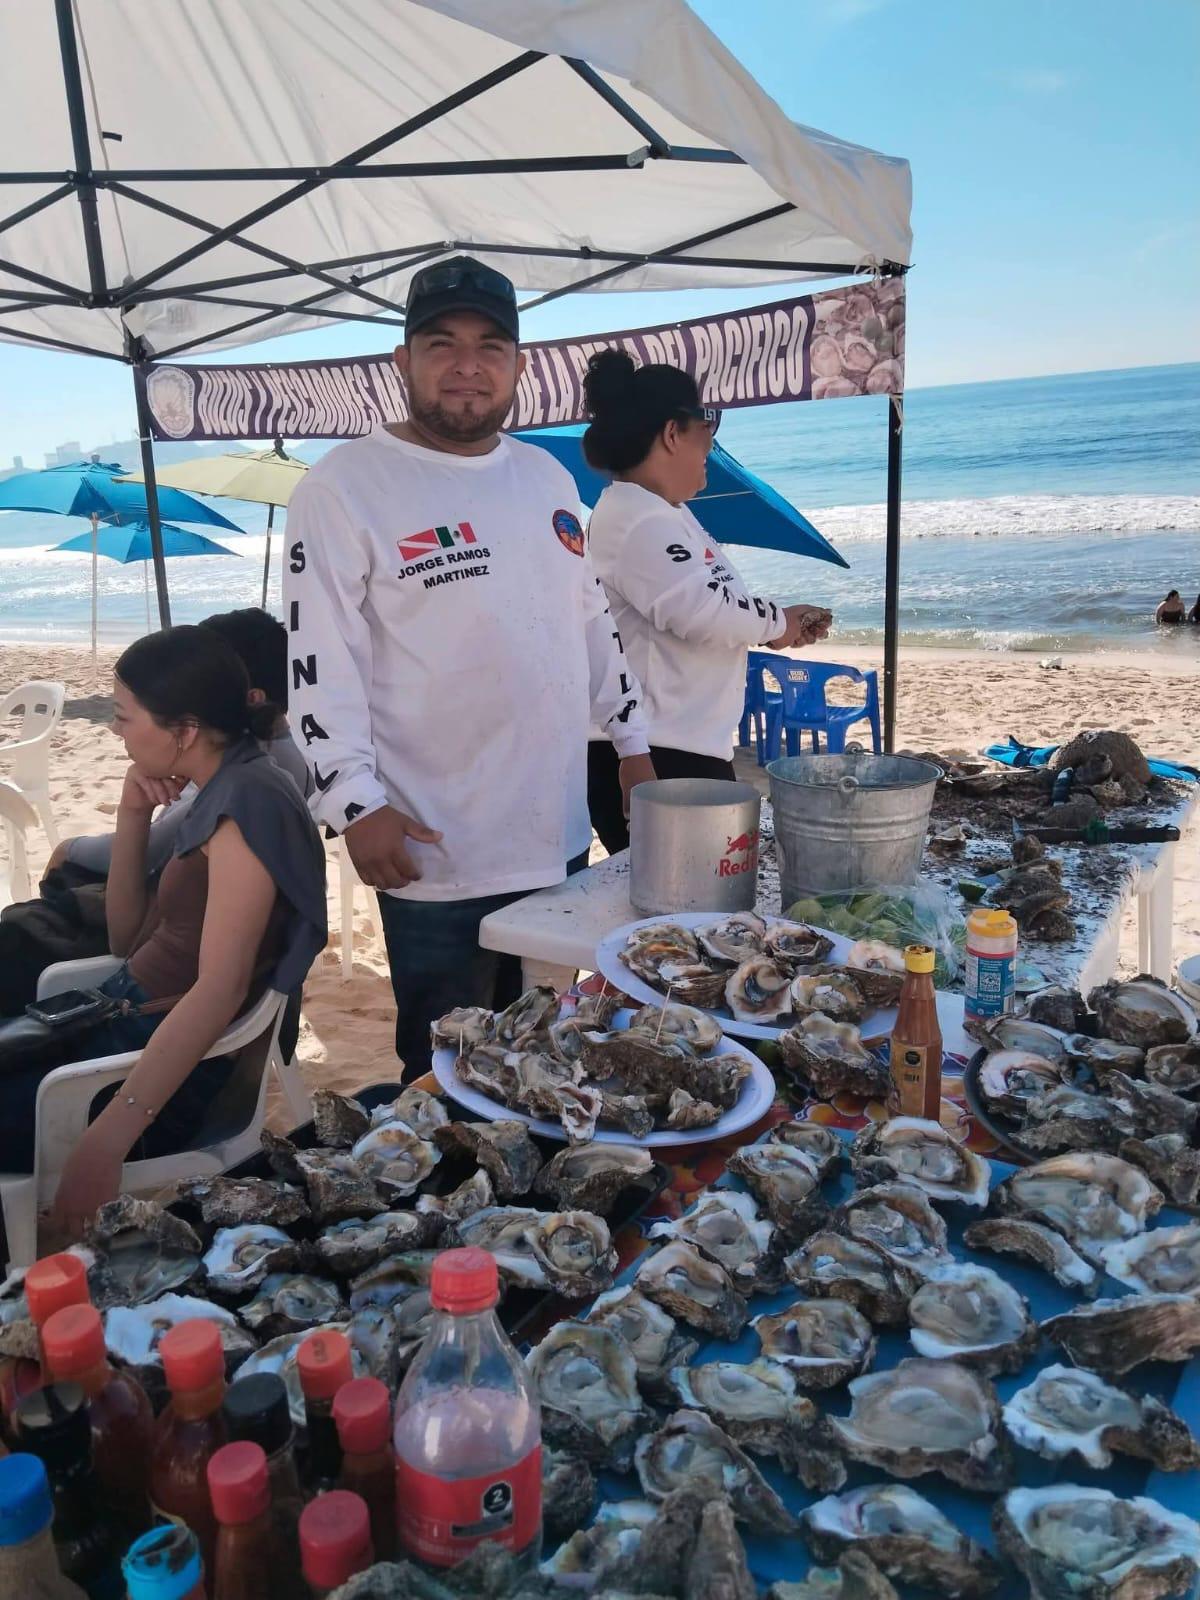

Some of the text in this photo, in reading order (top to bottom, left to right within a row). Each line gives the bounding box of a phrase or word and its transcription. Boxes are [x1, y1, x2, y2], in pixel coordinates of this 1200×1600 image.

[197, 369, 253, 435] BUZOS
[246, 370, 267, 433] Y
[259, 363, 383, 435] PESCADORES
[536, 346, 574, 423] LA
[689, 305, 808, 405] PACIFICO
[397, 547, 491, 580] JORGE RAMOS
[423, 565, 490, 589] MARTINEZ
[719, 853, 750, 877] Red
[492, 1488, 504, 1503] 2
